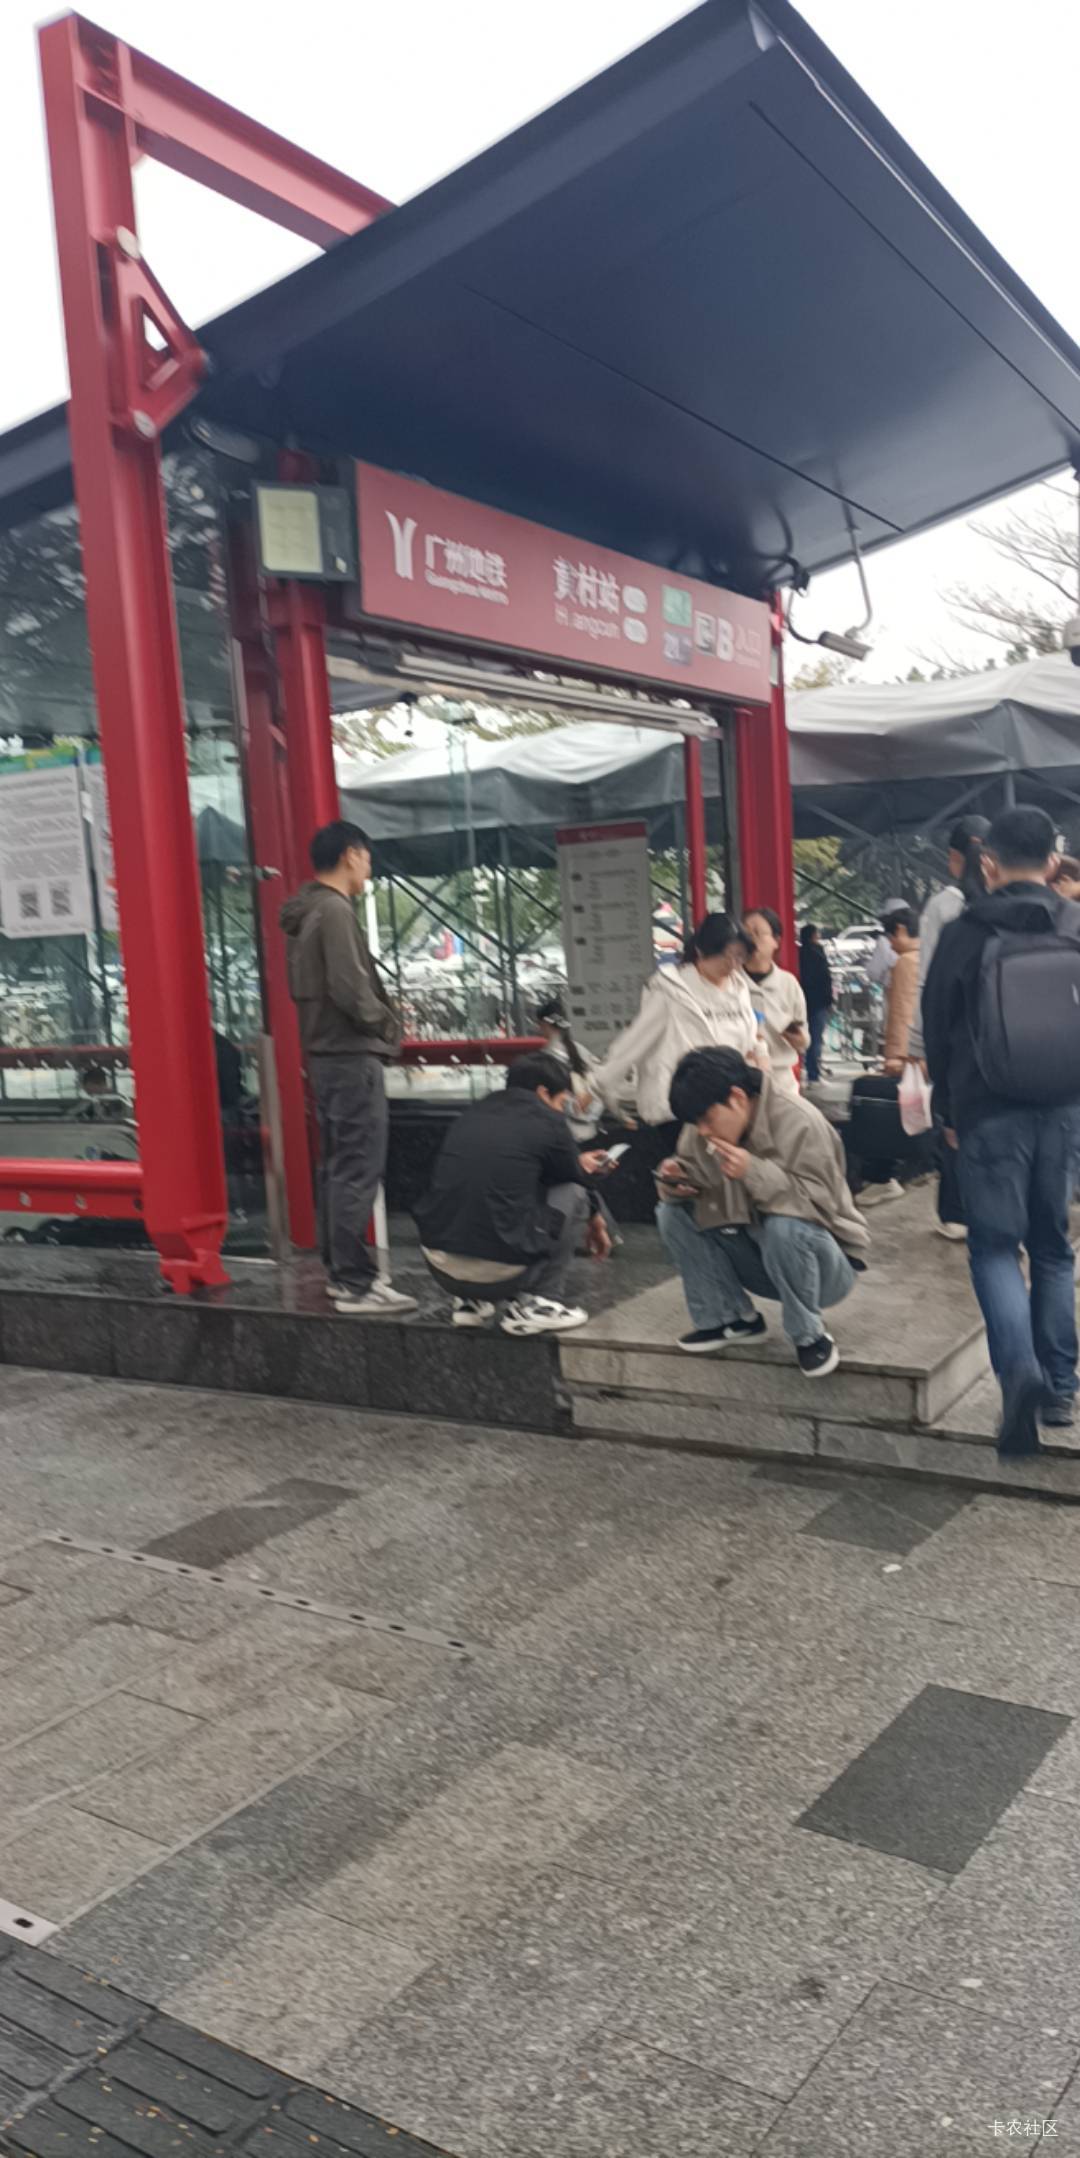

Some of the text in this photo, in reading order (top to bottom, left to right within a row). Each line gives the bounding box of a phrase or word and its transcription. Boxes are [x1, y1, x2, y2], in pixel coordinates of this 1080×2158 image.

[552, 555, 621, 616] 黄村站
[717, 617, 734, 662] B
